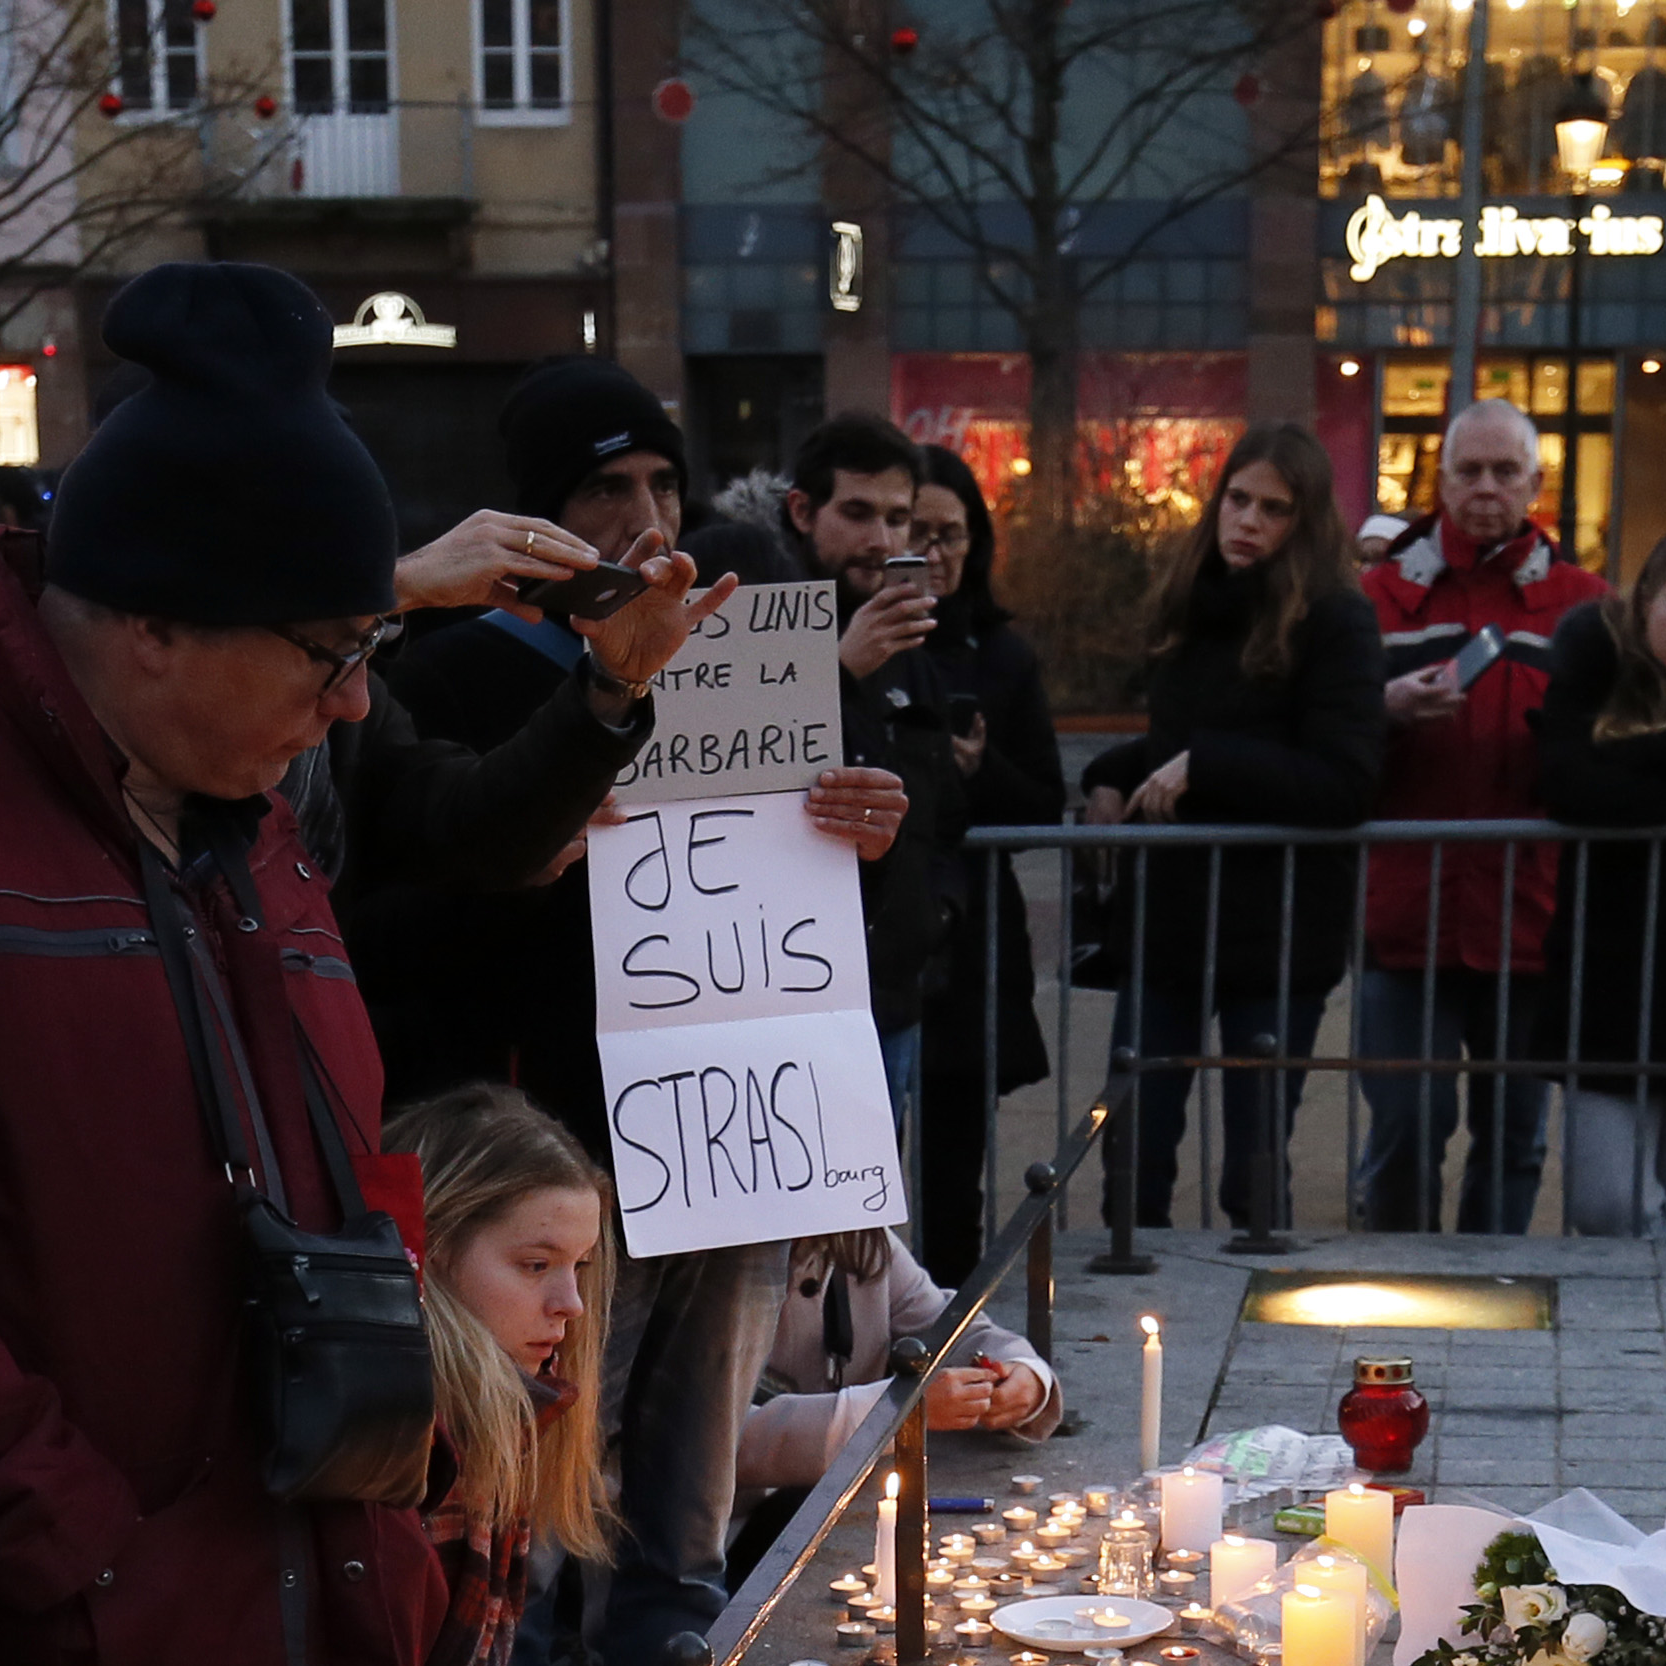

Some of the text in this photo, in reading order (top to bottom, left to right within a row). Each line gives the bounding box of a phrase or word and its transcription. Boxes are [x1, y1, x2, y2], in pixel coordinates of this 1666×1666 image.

[749, 585, 834, 632] UNIS
[653, 661, 798, 691] NTRE LA
[623, 808, 756, 912] JE
[621, 903, 835, 1010] SUIS
